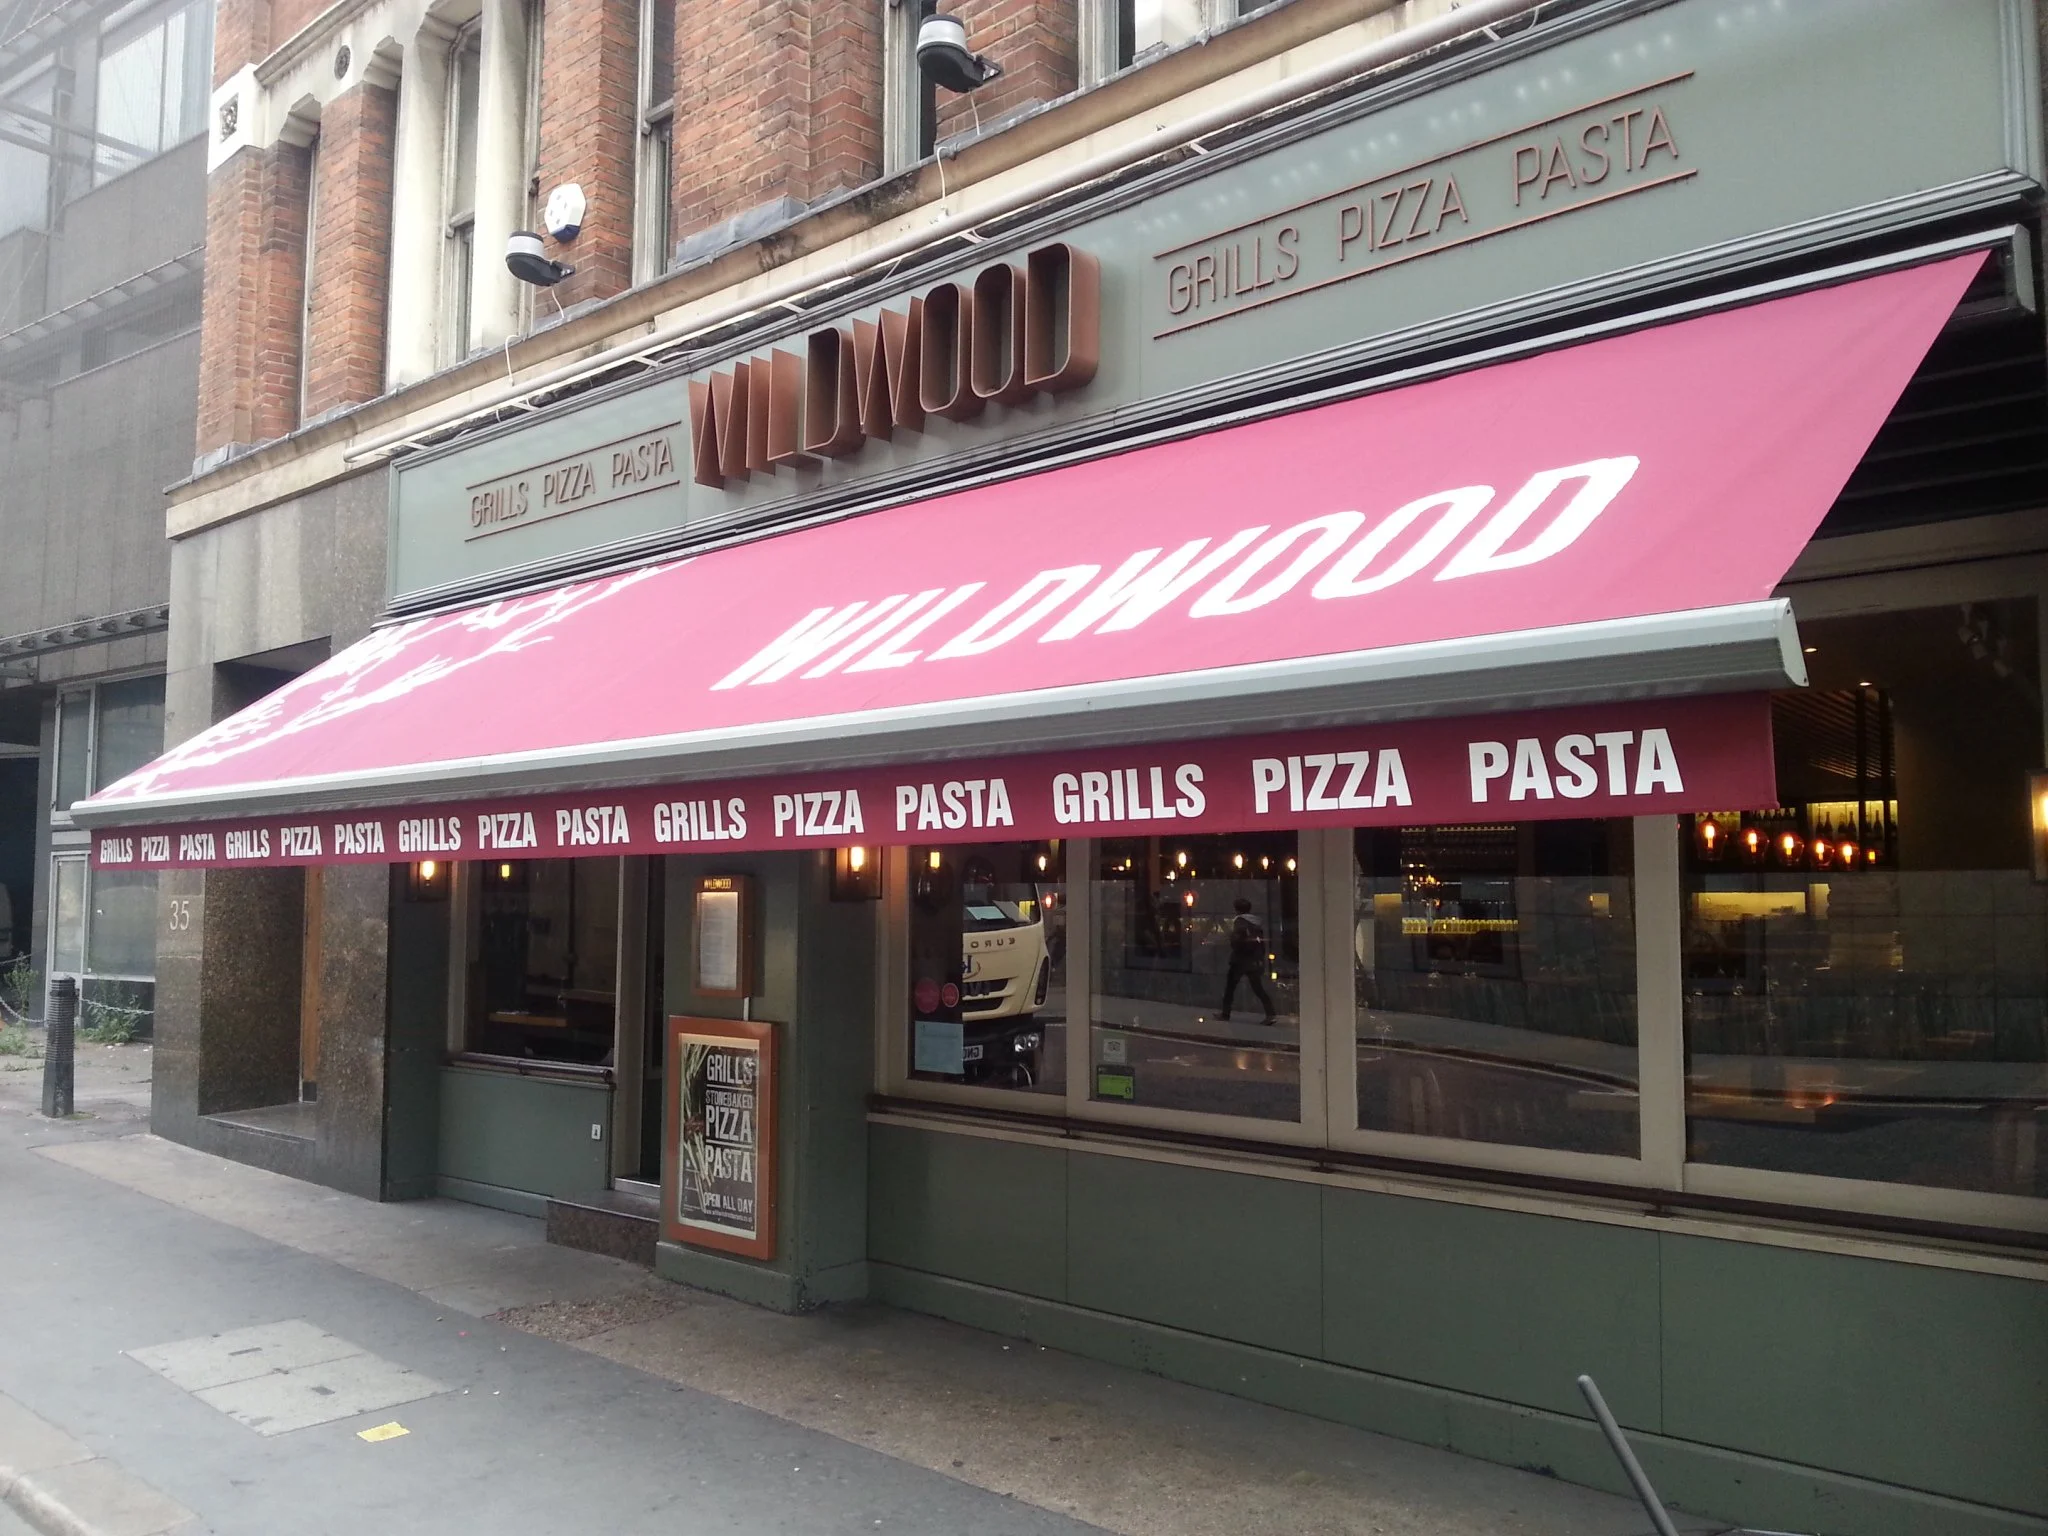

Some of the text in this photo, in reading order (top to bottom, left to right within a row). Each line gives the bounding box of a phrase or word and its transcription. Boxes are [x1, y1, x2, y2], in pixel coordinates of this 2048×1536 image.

[1166, 105, 1681, 316] GRILLS PIZZA PASTA
[688, 242, 1101, 489] WILDWOOD
[471, 437, 674, 528] GRILLS PIZZA PASTA
[711, 457, 1639, 690] WILDWOOD
[100, 729, 1684, 863] GRILLS PIZZA PASTA GRILLS PIZZA PASTA GRILLS PIZZA PASTA GRILLS PIZZA PASTA GRILLS PIZZA PASTA
[170, 900, 189, 930] 35
[707, 1054, 753, 1085] GRILLS
[706, 1090, 753, 1109] STONEBAKED
[706, 1105, 752, 1143] PIZZA
[705, 1145, 752, 1183] PASTA
[704, 1192, 721, 1207] OPEN
[723, 1195, 736, 1211] ALL
[737, 1198, 753, 1213] DAY
